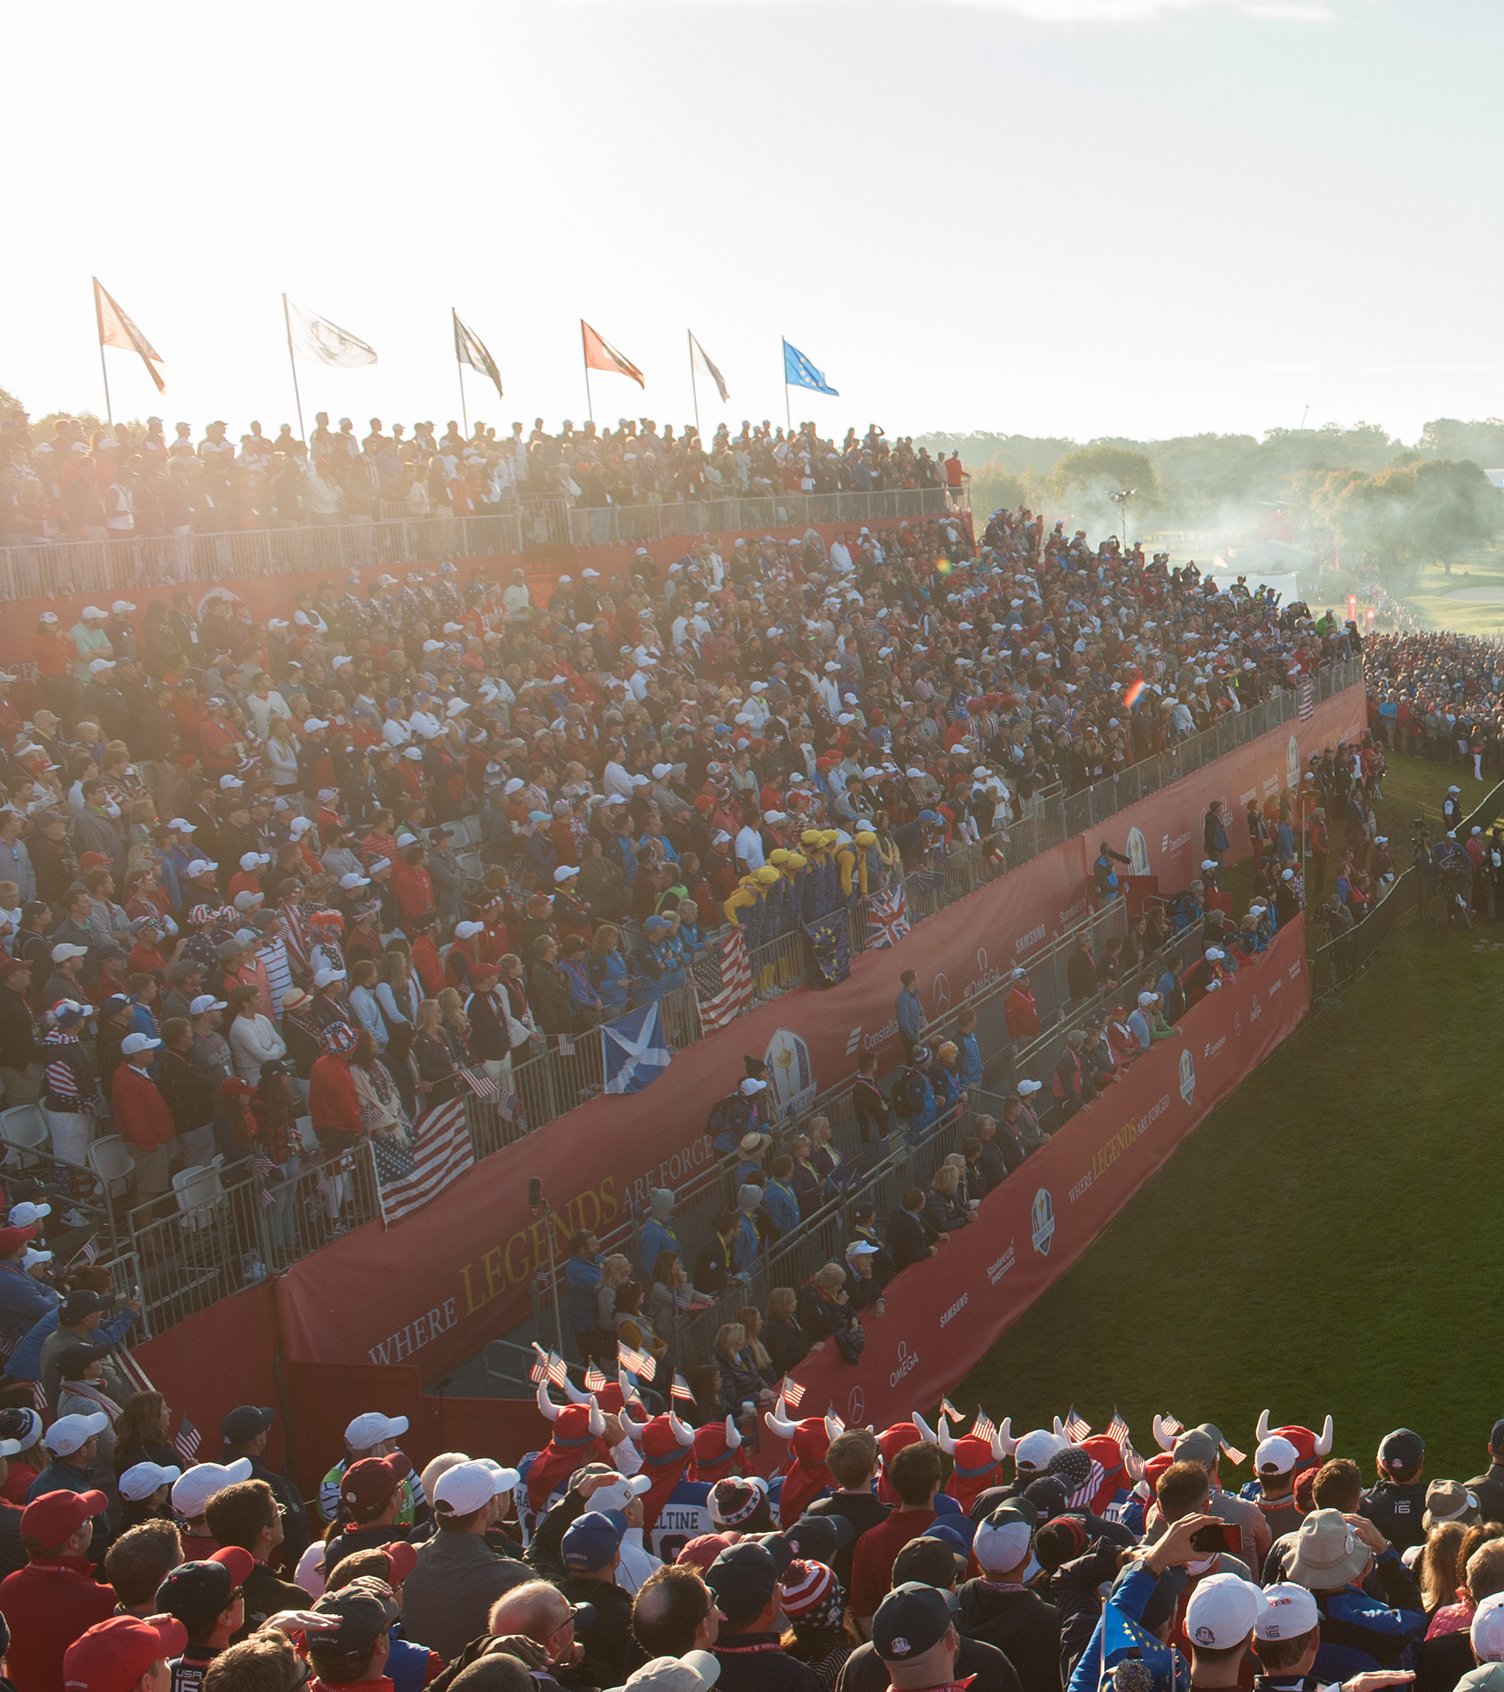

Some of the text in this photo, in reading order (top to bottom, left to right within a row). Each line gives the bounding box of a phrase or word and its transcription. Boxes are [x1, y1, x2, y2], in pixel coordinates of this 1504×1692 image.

[1015, 923, 1046, 954] SAMSUNG
[863, 1017, 899, 1051] Constella
[1068, 1171, 1093, 1205] WHERE
[1091, 1116, 1138, 1181] LEGENDS
[367, 1296, 459, 1366] WHERE
[459, 1174, 619, 1317] LEGENDS
[658, 1134, 715, 1189] FORGE
[939, 1292, 969, 1329] SAMSUNG
[889, 1351, 920, 1388] OMEGA
[1394, 1504, 1411, 1514] 16
[175, 1668, 203, 1680] USA
